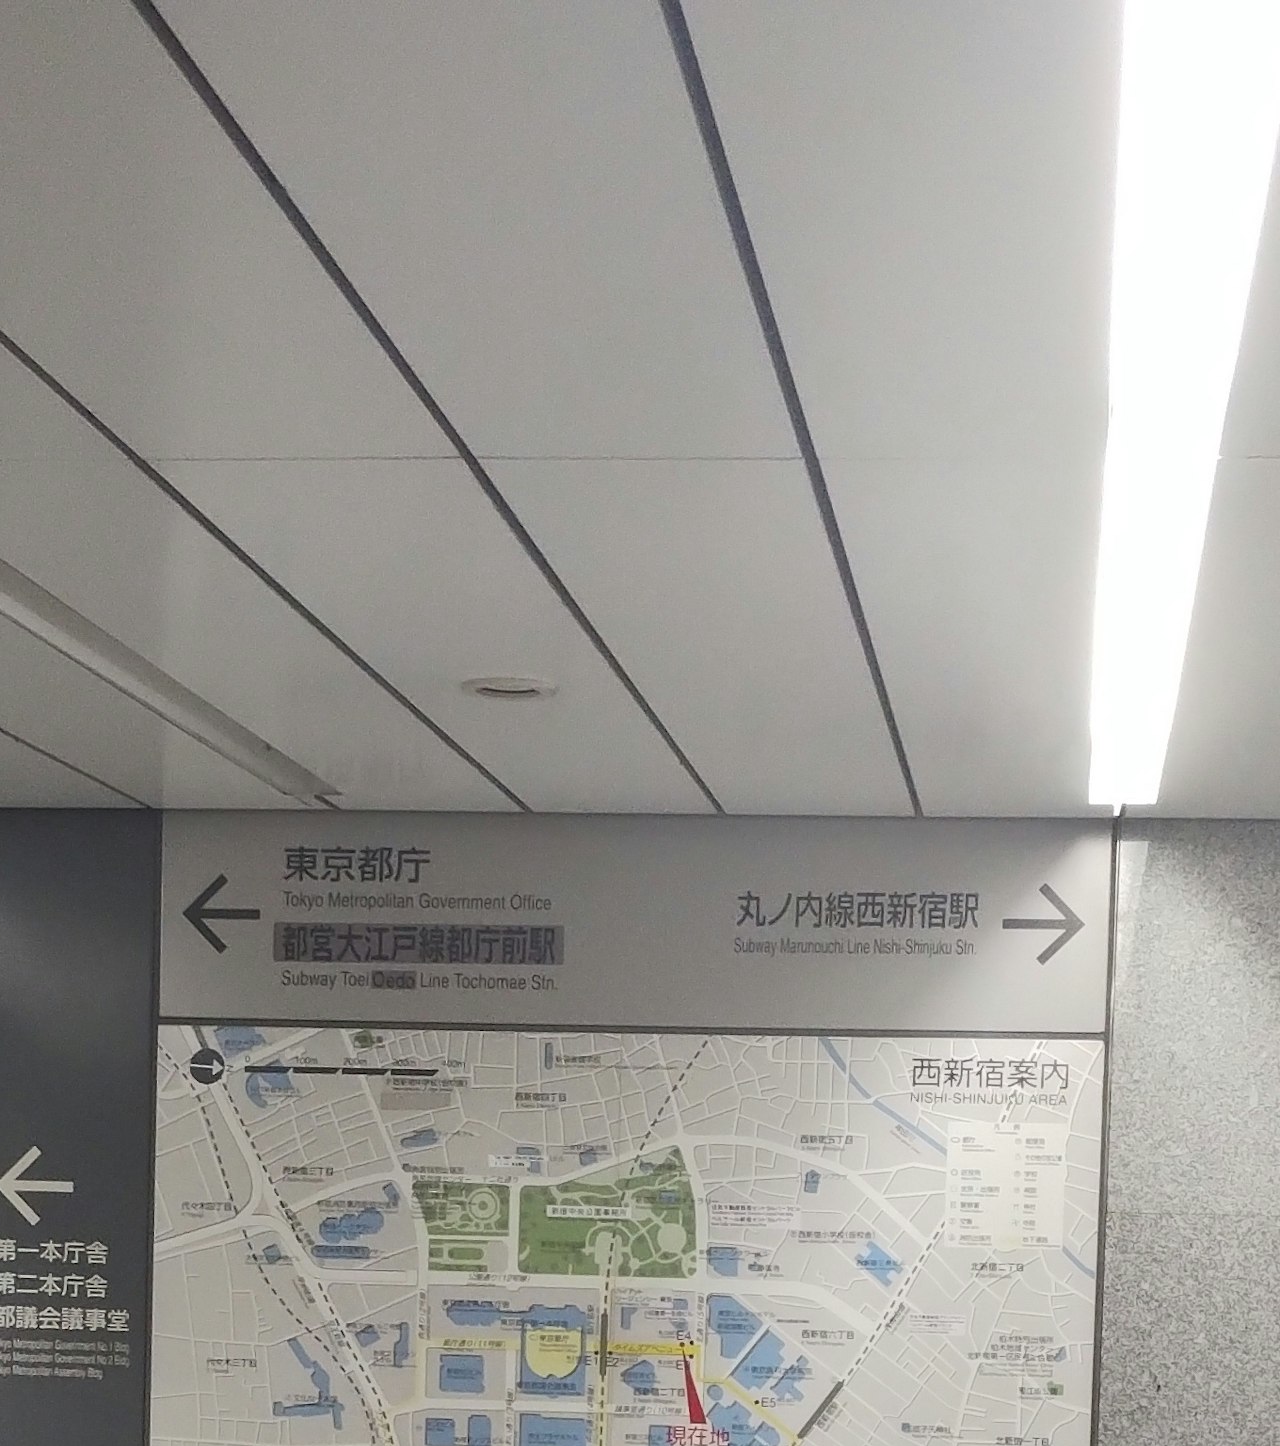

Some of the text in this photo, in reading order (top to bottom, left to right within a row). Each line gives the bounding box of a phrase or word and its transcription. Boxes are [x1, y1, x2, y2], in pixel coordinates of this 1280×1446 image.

[283, 846, 431, 883] 東京都庁
[283, 891, 552, 911] Tokyo Metropolitan Government Office
[736, 891, 979, 929] 丸ノ内線西新宿駅
[281, 925, 556, 964] 都営大江戸線都庁前駅
[733, 938, 778, 956] Subway
[780, 938, 844, 955] Marunouchi
[847, 939, 870, 955] Line
[873, 939, 953, 957] Nishi-Shinjuku
[281, 971, 559, 990] Subway Toei Oedo Line Tochomae Stn.
[911, 1057, 1069, 1090] 西新宿案内
[910, 1091, 1068, 1106] NISHI-SHINJUKU AREA
[676, 1330, 692, 1341] E4
[761, 1397, 777, 1408] E5
